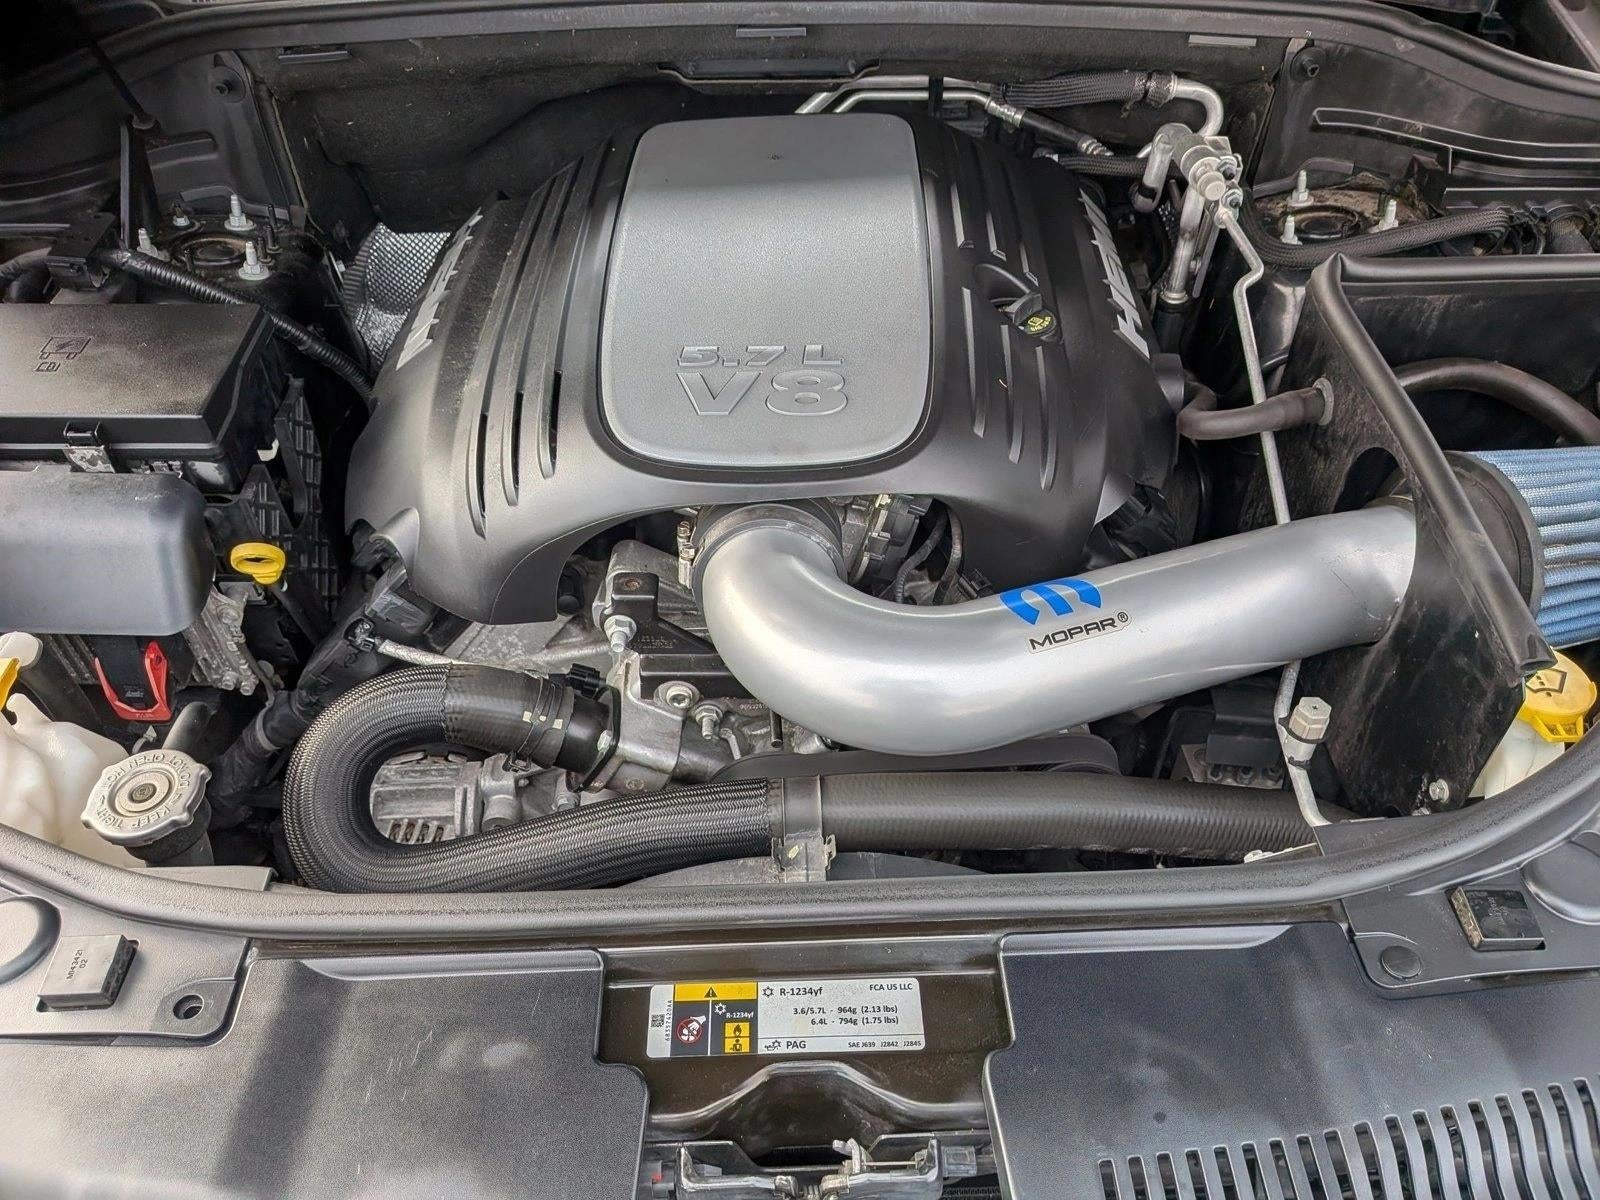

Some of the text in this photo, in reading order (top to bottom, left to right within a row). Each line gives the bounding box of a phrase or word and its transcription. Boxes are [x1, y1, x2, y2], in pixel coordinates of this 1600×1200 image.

[676, 369, 849, 417] V8
[129, 753, 165, 769] OPEN
[96, 804, 171, 830] KEEP TIGHT
[779, 986, 823, 997] R-1234yf
[869, 982, 913, 991] FCA US LLC
[725, 1011, 754, 1019] R-1234yf
[793, 1006, 827, 1016] 3.6/5.7L
[837, 1006, 858, 1015] 964g
[861, 1005, 881, 1015] (2.13
[883, 1004, 898, 1014] lbs)
[810, 1018, 828, 1026] 6.4L
[838, 1017, 858, 1026] 794g
[862, 1016, 883, 1025] (1.75
[884, 1015, 899, 1025] lbs)
[786, 1040, 807, 1050] PAG
